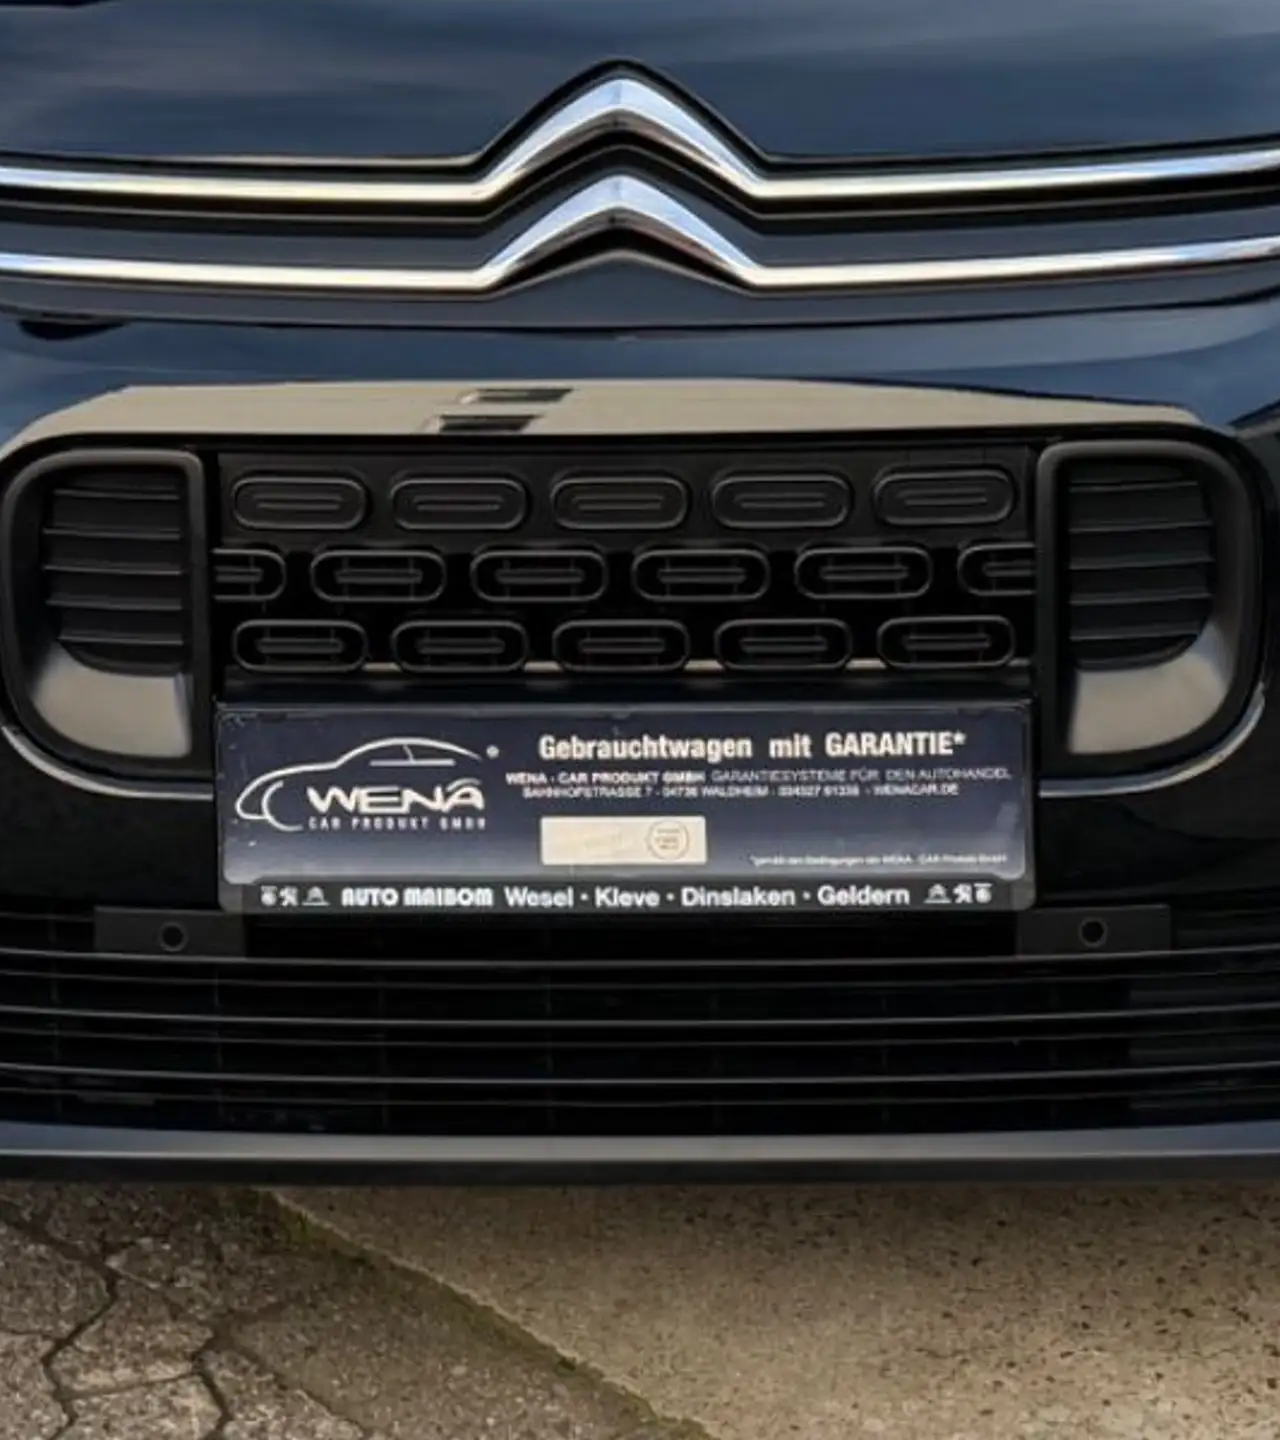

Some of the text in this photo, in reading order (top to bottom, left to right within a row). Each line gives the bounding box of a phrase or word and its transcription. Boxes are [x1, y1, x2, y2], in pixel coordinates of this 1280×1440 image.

[538, 733, 752, 764] Gebrauchtwagen
[769, 732, 812, 758] mit
[505, 771, 548, 785] WENA
[557, 771, 588, 784] CAR
[592, 771, 660, 784] PRODUKT
[341, 883, 911, 907] AUTO MAIBOM Wesel Kleve Dinslaken Geldern
